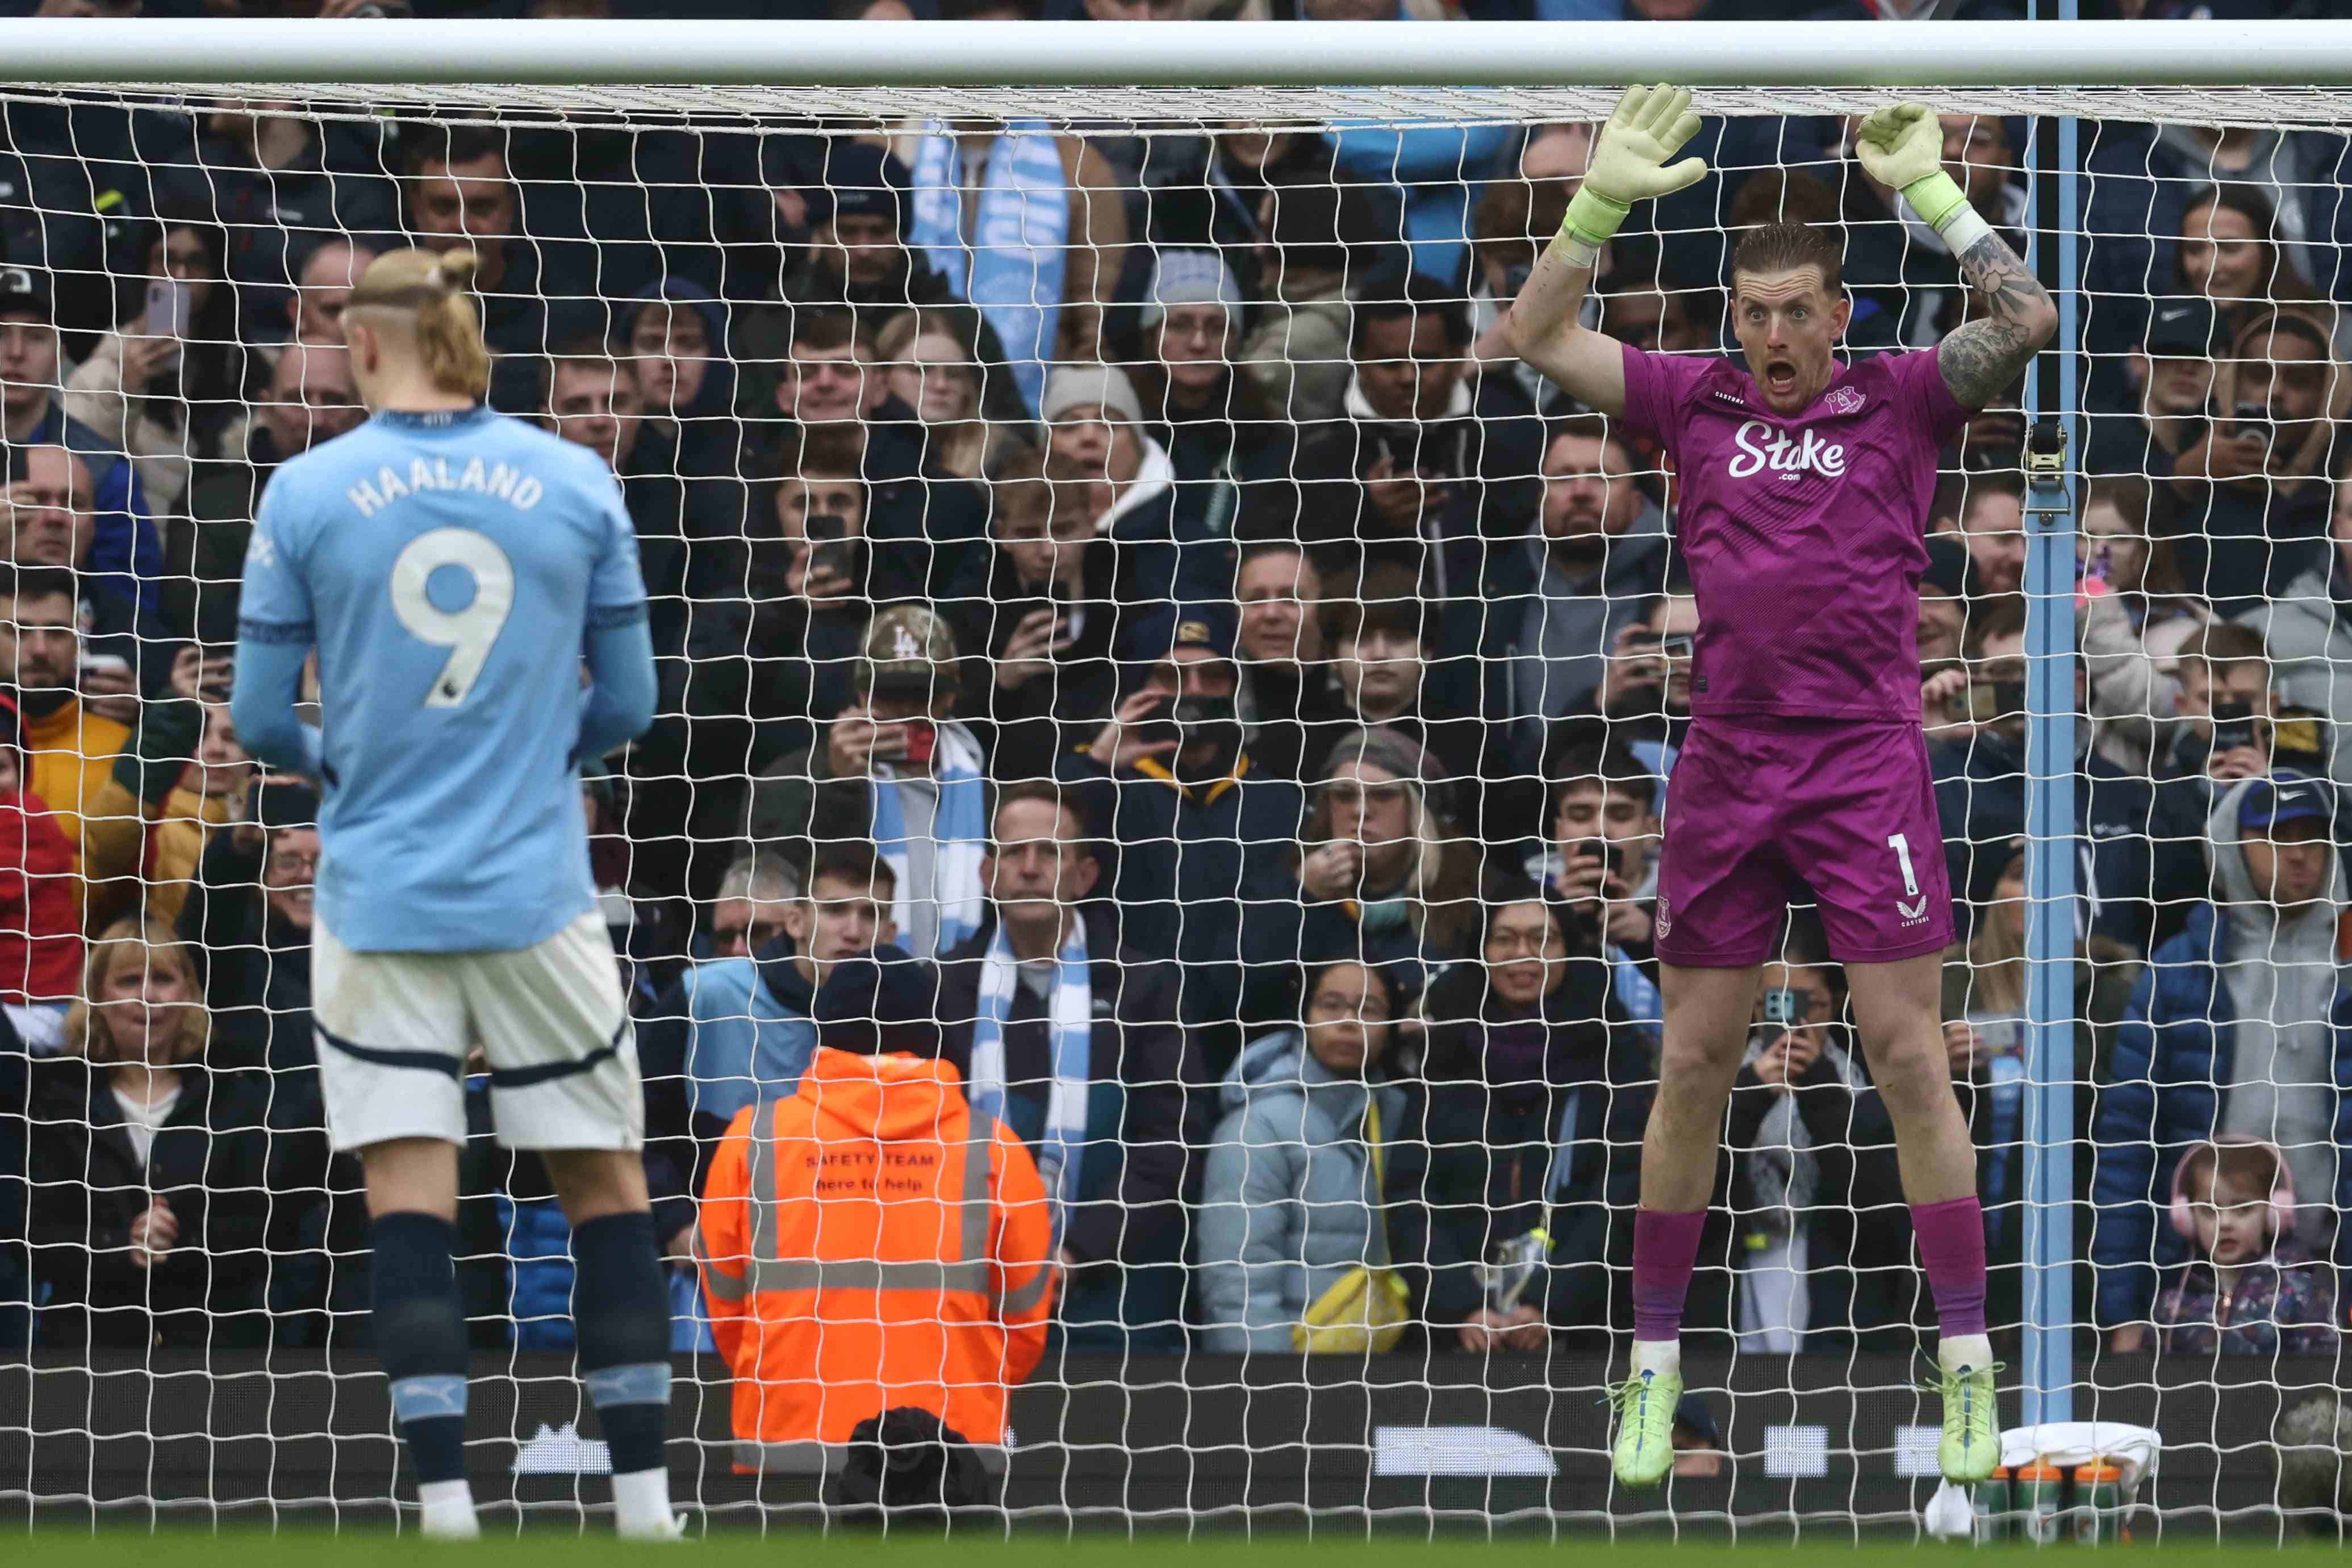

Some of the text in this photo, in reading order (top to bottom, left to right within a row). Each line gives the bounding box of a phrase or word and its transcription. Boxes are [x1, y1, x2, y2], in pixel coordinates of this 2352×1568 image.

[1728, 420, 1845, 478] Stake
[346, 454, 544, 518] HAALAND
[1778, 473, 1802, 481] .com
[390, 526, 515, 709] 9
[892, 625, 919, 659] LA
[1887, 833, 1919, 896] 1
[1901, 916, 1930, 927] CASTORE
[806, 1153, 934, 1167] SAFETY TEAM
[816, 1178, 922, 1191] here to help
